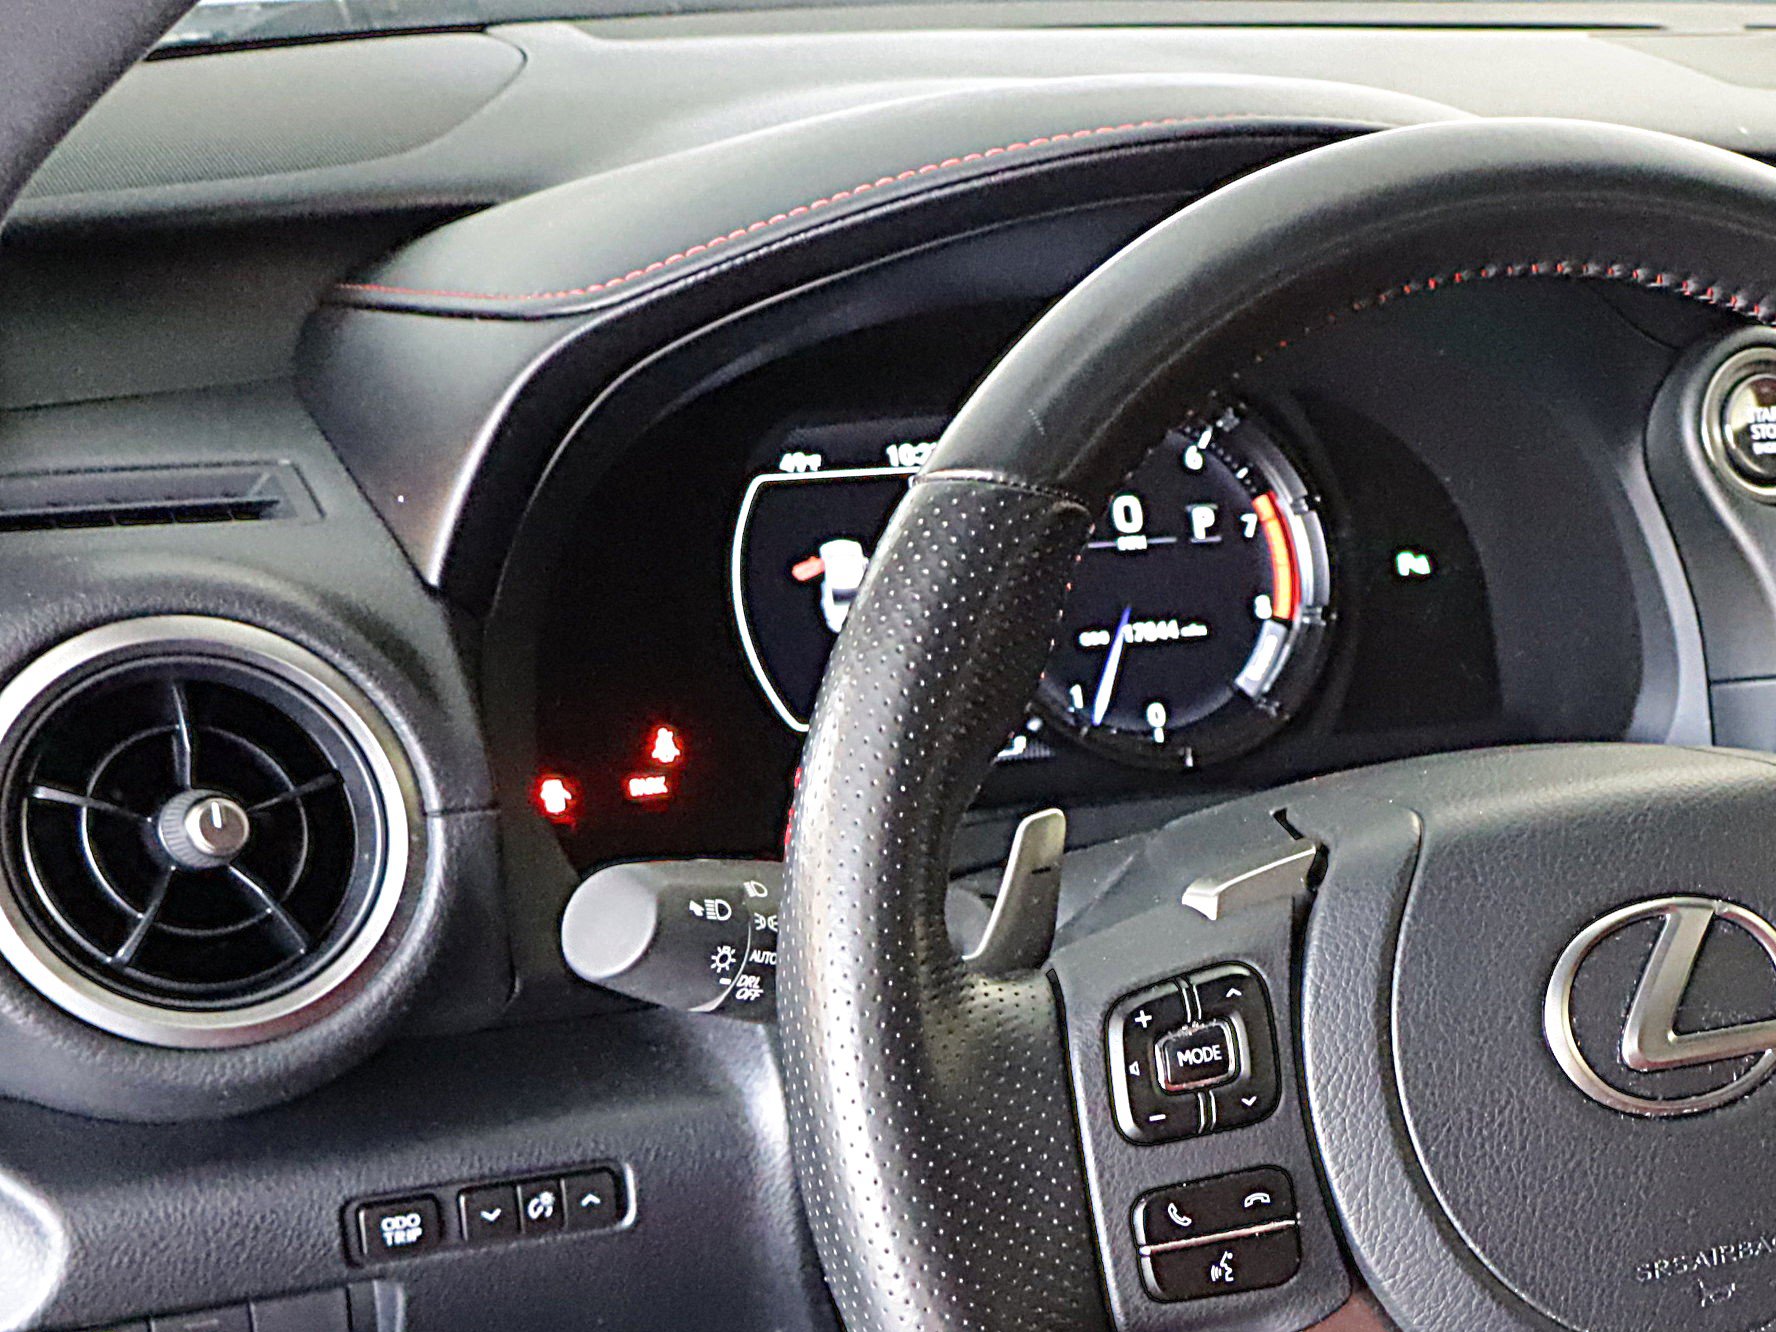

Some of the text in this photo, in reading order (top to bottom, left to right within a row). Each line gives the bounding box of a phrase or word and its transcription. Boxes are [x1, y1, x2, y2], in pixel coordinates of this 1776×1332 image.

[1185, 444, 1204, 471] 6
[1112, 495, 1144, 534] 0
[1191, 506, 1216, 540] P
[1240, 513, 1258, 539] 7
[1069, 683, 1084, 709] 1
[1146, 701, 1167, 728] 0
[735, 987, 764, 1002] OFF
[736, 974, 761, 990] DRL
[1176, 1045, 1223, 1067] MODE
[381, 1213, 422, 1232] ODO
[382, 1227, 423, 1246] TRIP
[1635, 1253, 1689, 1283] SRS
